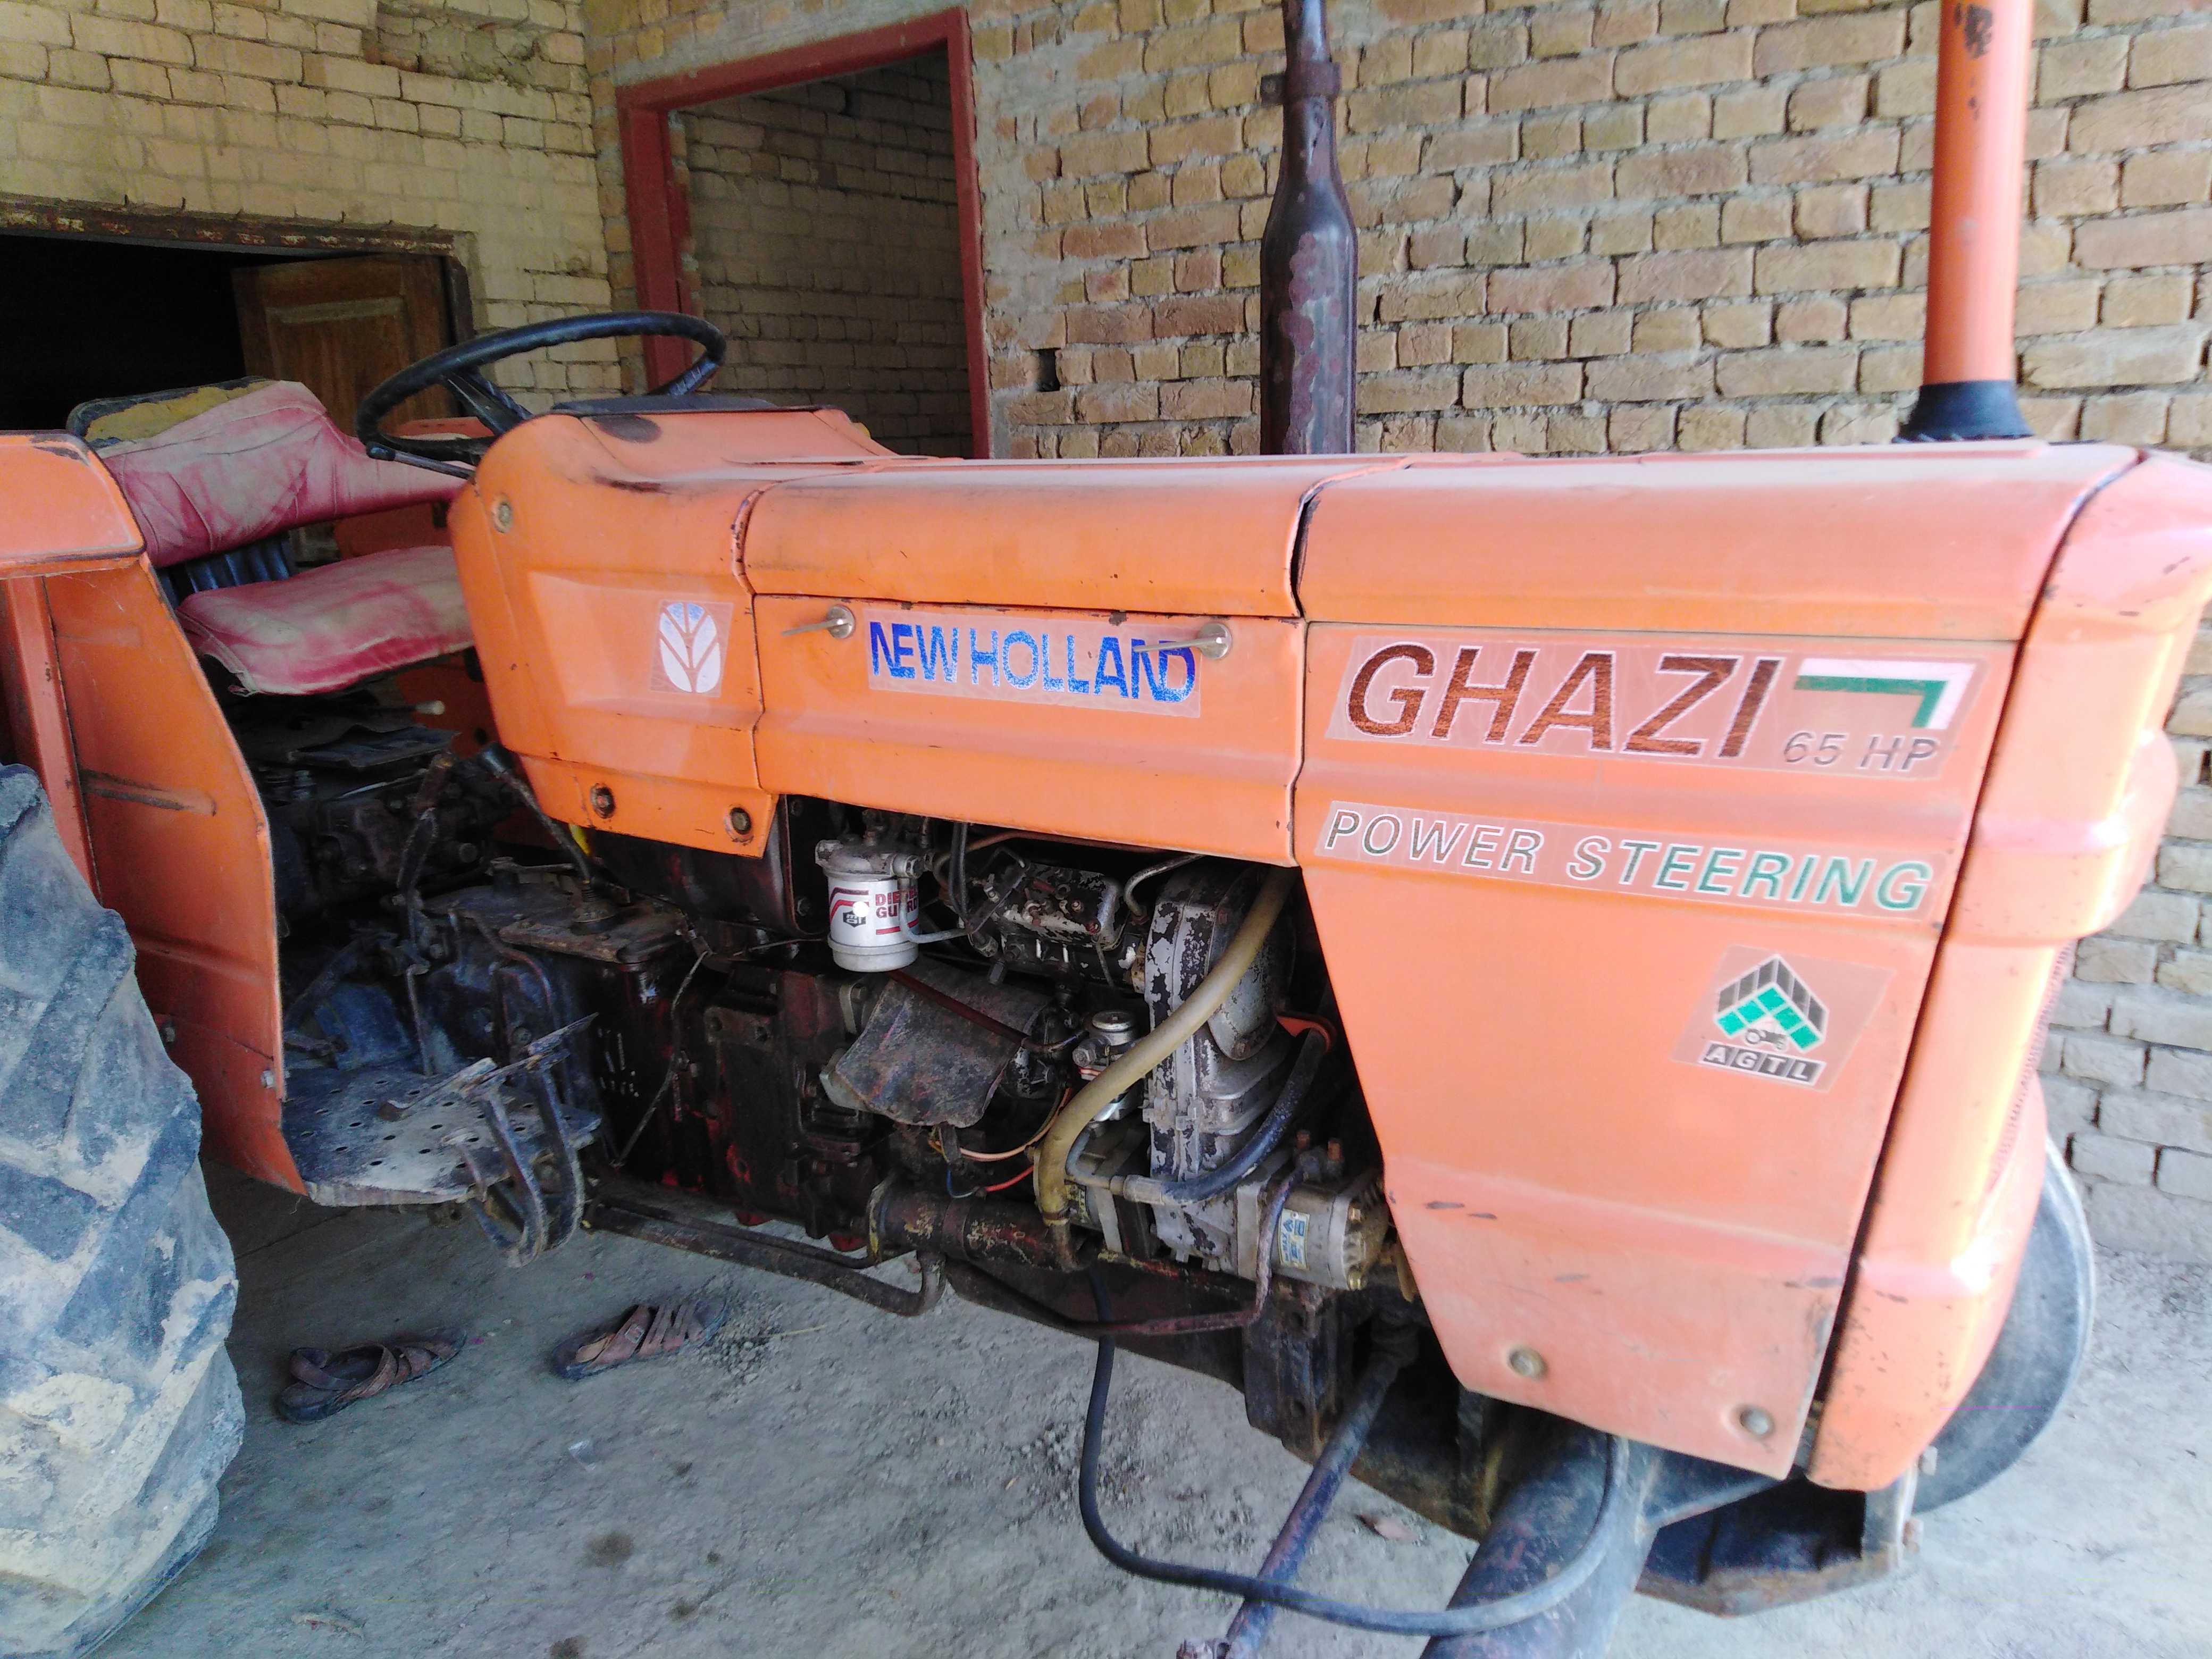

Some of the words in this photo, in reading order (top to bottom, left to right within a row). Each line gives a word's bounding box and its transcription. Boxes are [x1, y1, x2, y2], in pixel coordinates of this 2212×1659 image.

[870, 621, 959, 683] NEW
[969, 627, 1195, 703] HOLLAND
[1346, 642, 1783, 759] GHAZI
[1783, 731, 1849, 766] 65
[1856, 735, 1940, 771] HP
[1324, 808, 1544, 876] POWER
[1565, 836, 1932, 911] STEERING
[876, 898, 918, 919] GURD
[1705, 1046, 1809, 1080] AGTL
